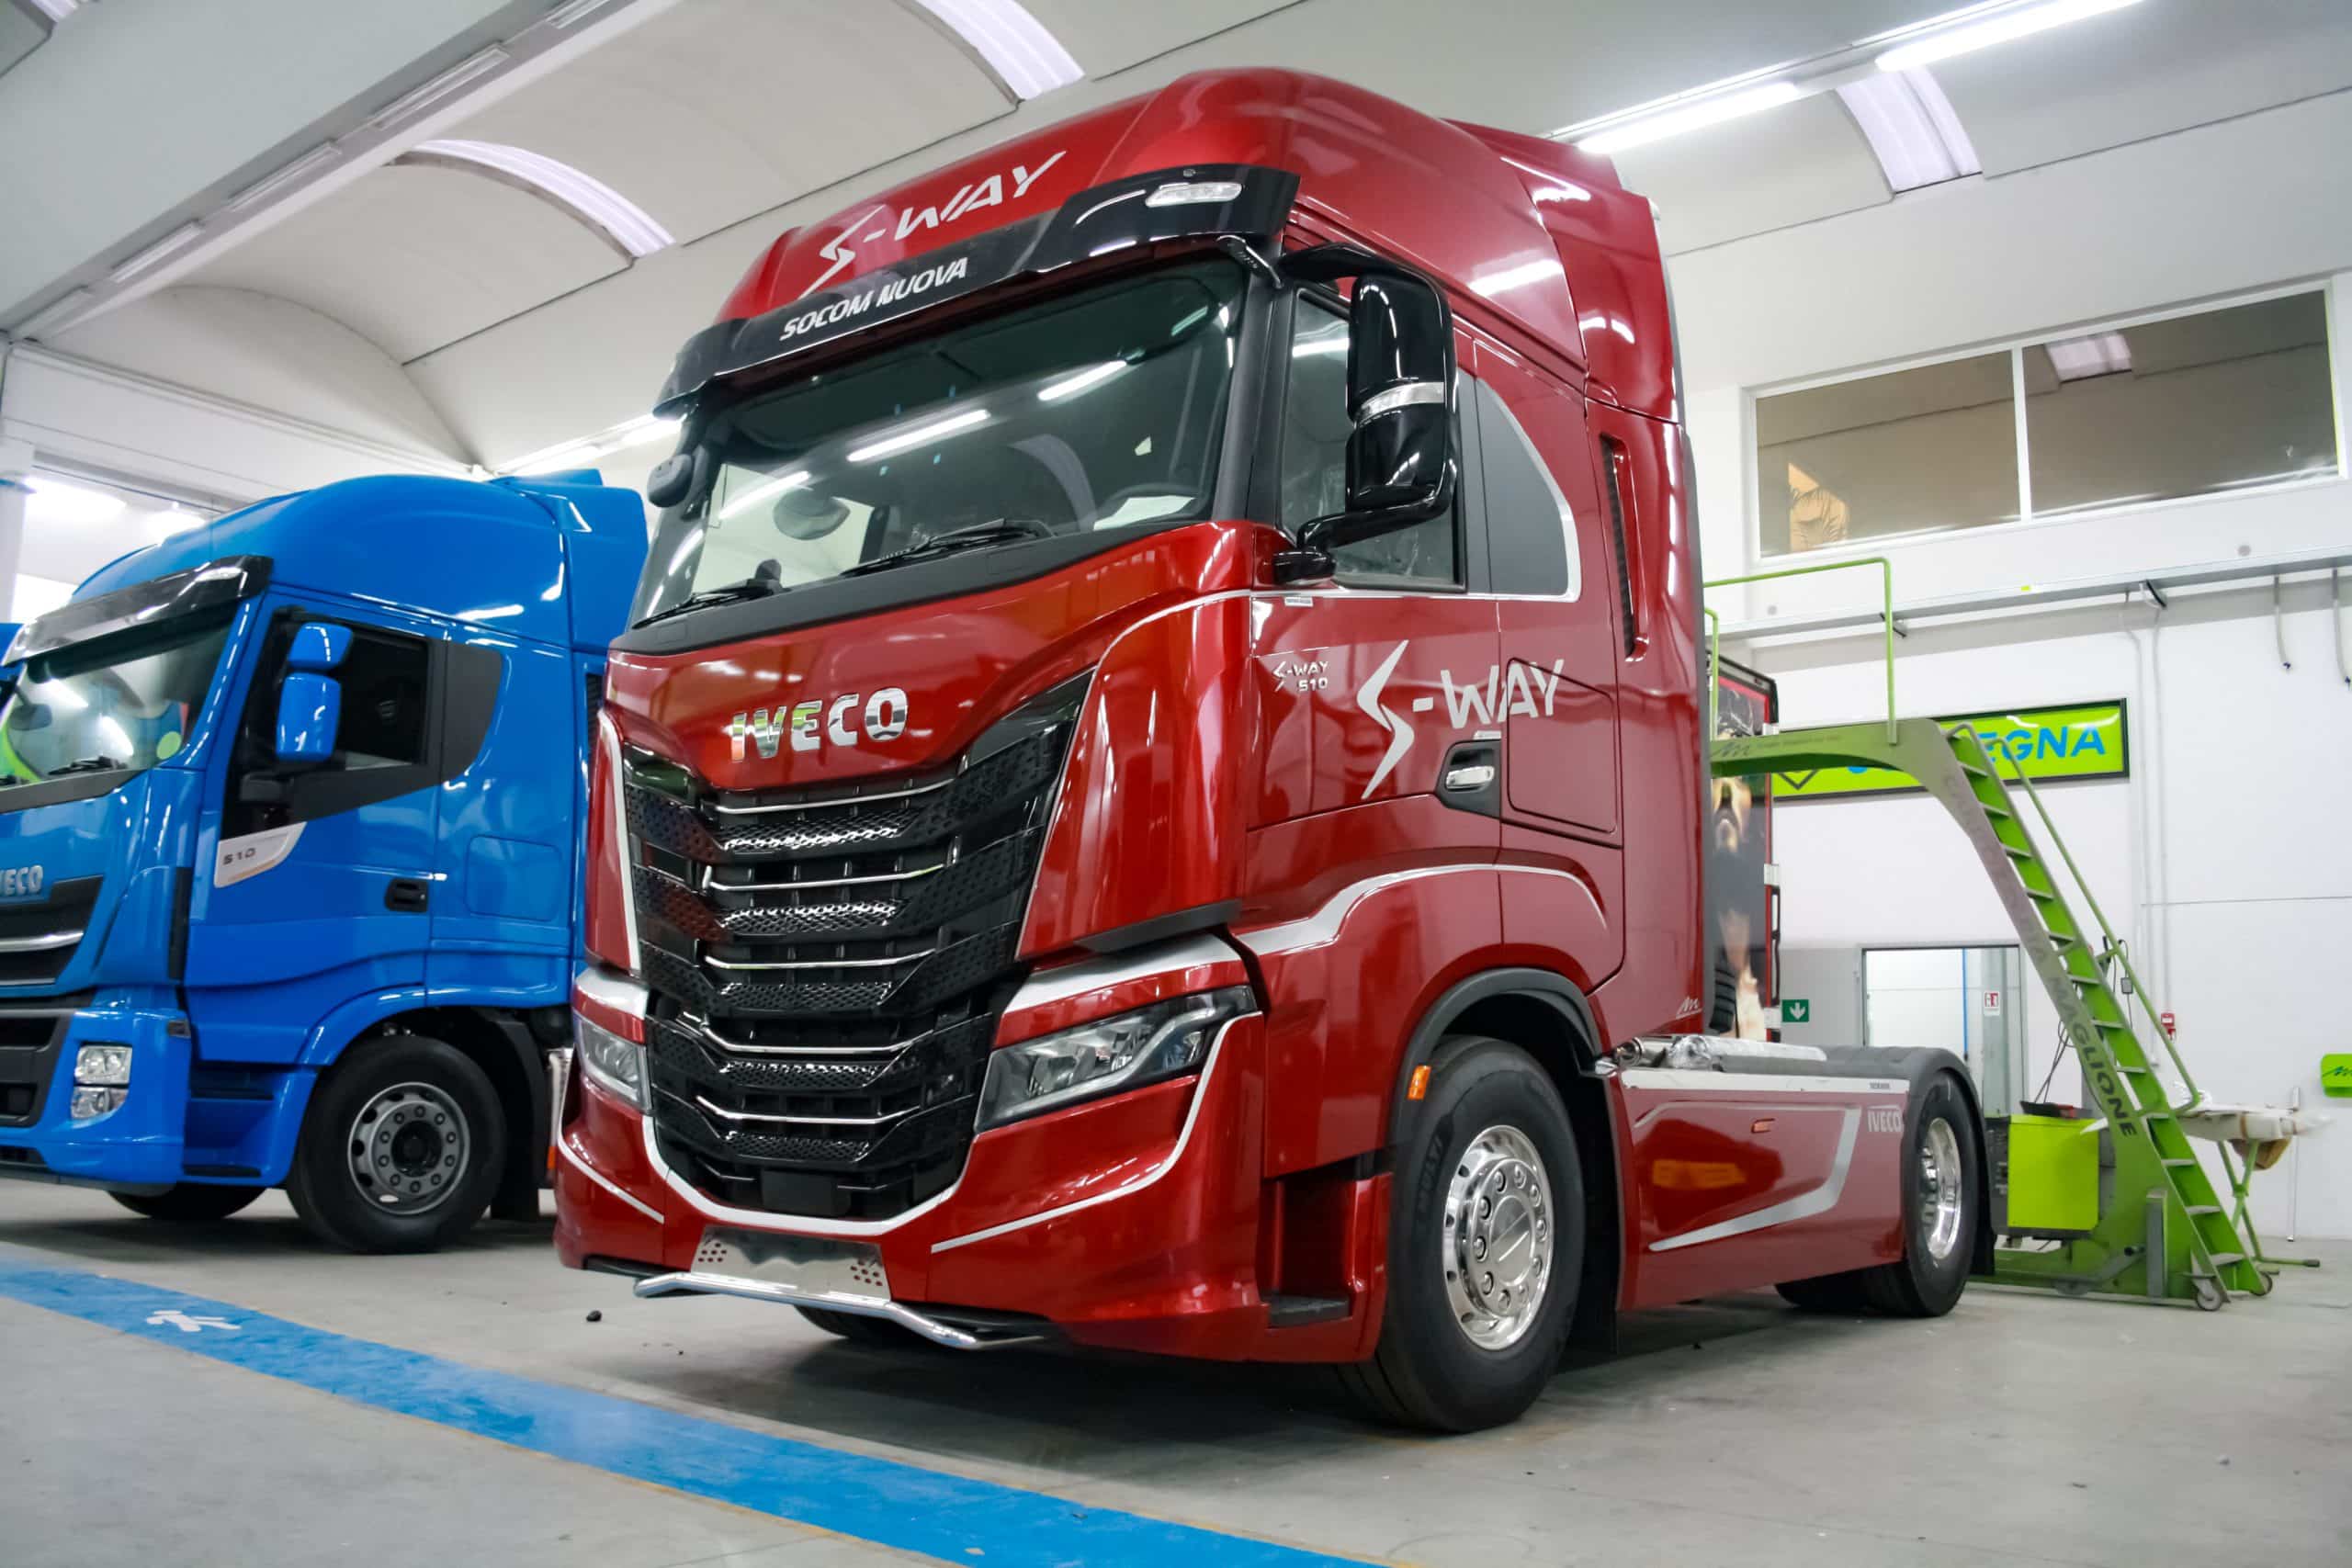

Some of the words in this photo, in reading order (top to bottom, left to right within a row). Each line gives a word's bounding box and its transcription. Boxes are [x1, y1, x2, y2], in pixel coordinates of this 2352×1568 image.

[797, 151, 1067, 299] S-WAY
[779, 291, 874, 341] SOCOM
[876, 257, 967, 306] NUOVA
[1272, 660, 1329, 692] S-WAY
[1298, 677, 1329, 692] 510
[730, 687, 909, 763] IVECO
[1357, 639, 1564, 799] S-WAY
[223, 847, 256, 865] 510
[0, 864, 43, 895] ECO
[1868, 1110, 1903, 1133] IVECO
